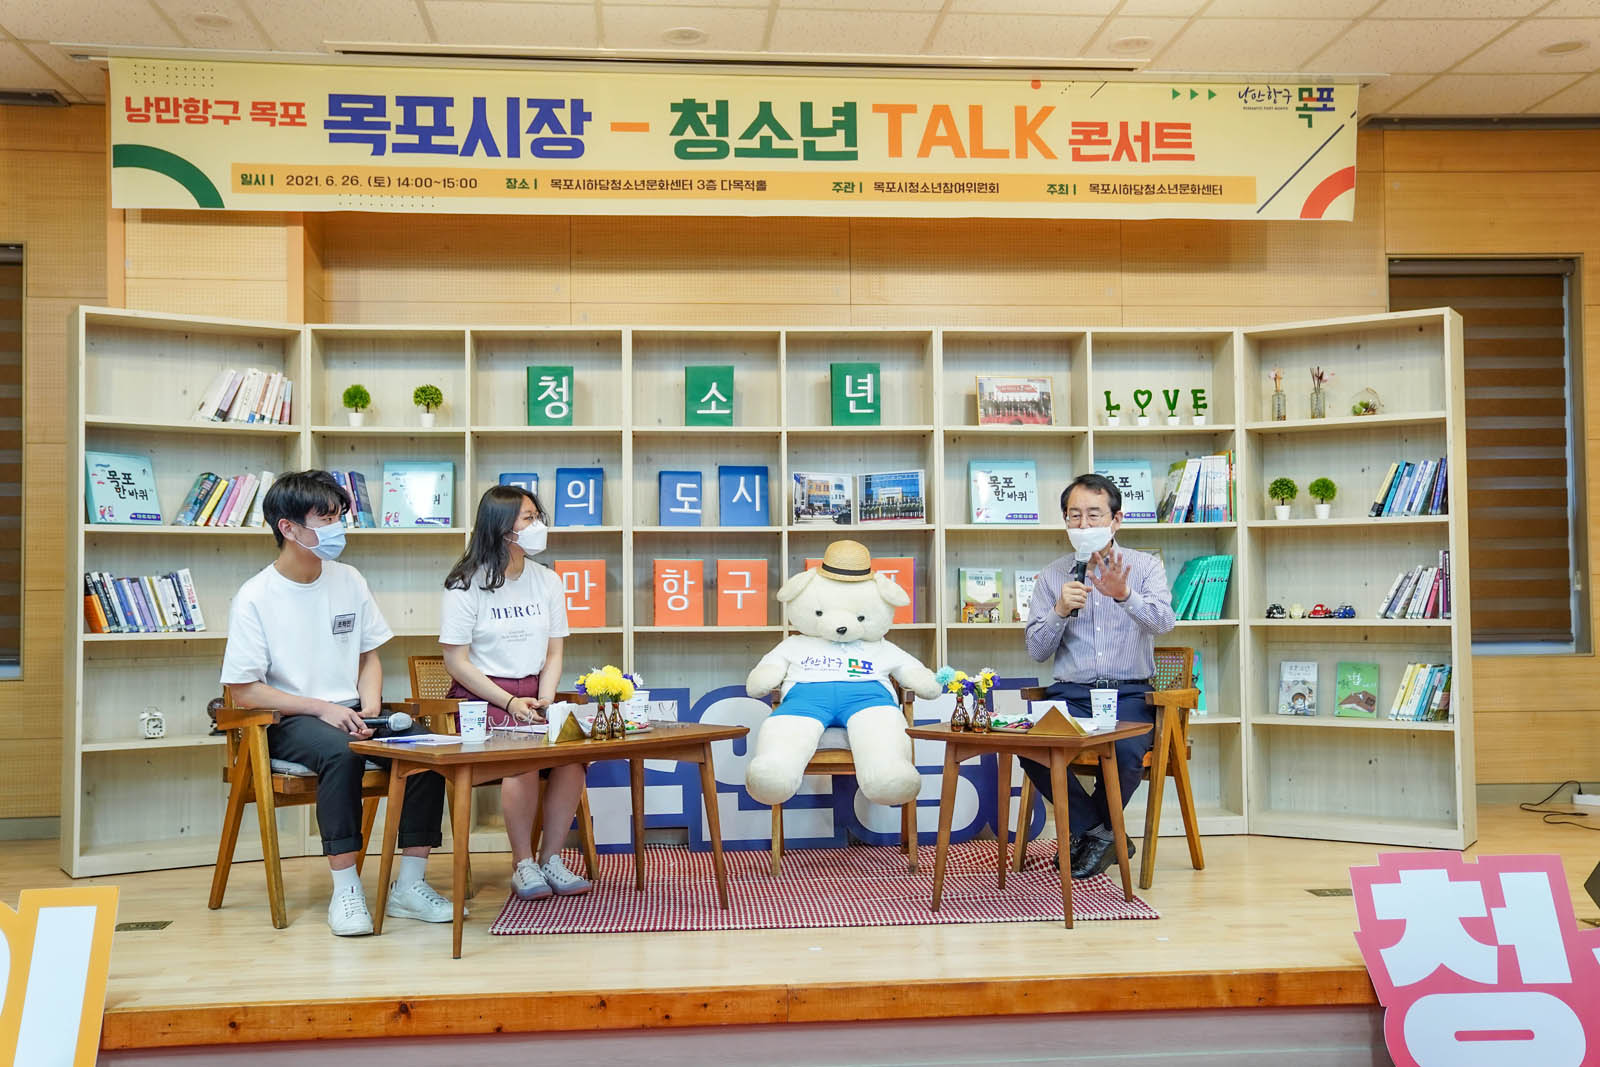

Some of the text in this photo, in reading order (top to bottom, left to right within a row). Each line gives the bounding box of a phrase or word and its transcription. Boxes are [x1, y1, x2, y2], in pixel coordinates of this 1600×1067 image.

[124, 96, 241, 126] 낭만항구
[249, 101, 307, 127] 목포
[323, 93, 592, 159] 목포시장
[669, 98, 858, 161] 청소년
[872, 103, 1059, 160] TALK
[1068, 121, 1195, 163] 콘서트
[240, 173, 1223, 196] 일시 2021. 6. 26. (토) 14:00~15:00 장소 목포시하당청소년문화센터 3층 다목적홀 주관 목포시청소년참여위원회 주최 목포시하당청소년문화센터
[538, 373, 875, 419] 청 소 년
[106, 470, 135, 487] 목포
[988, 476, 1015, 490] 목포
[564, 479, 594, 514] 의
[563, 570, 597, 610] 만
[491, 603, 541, 619] MERCI
